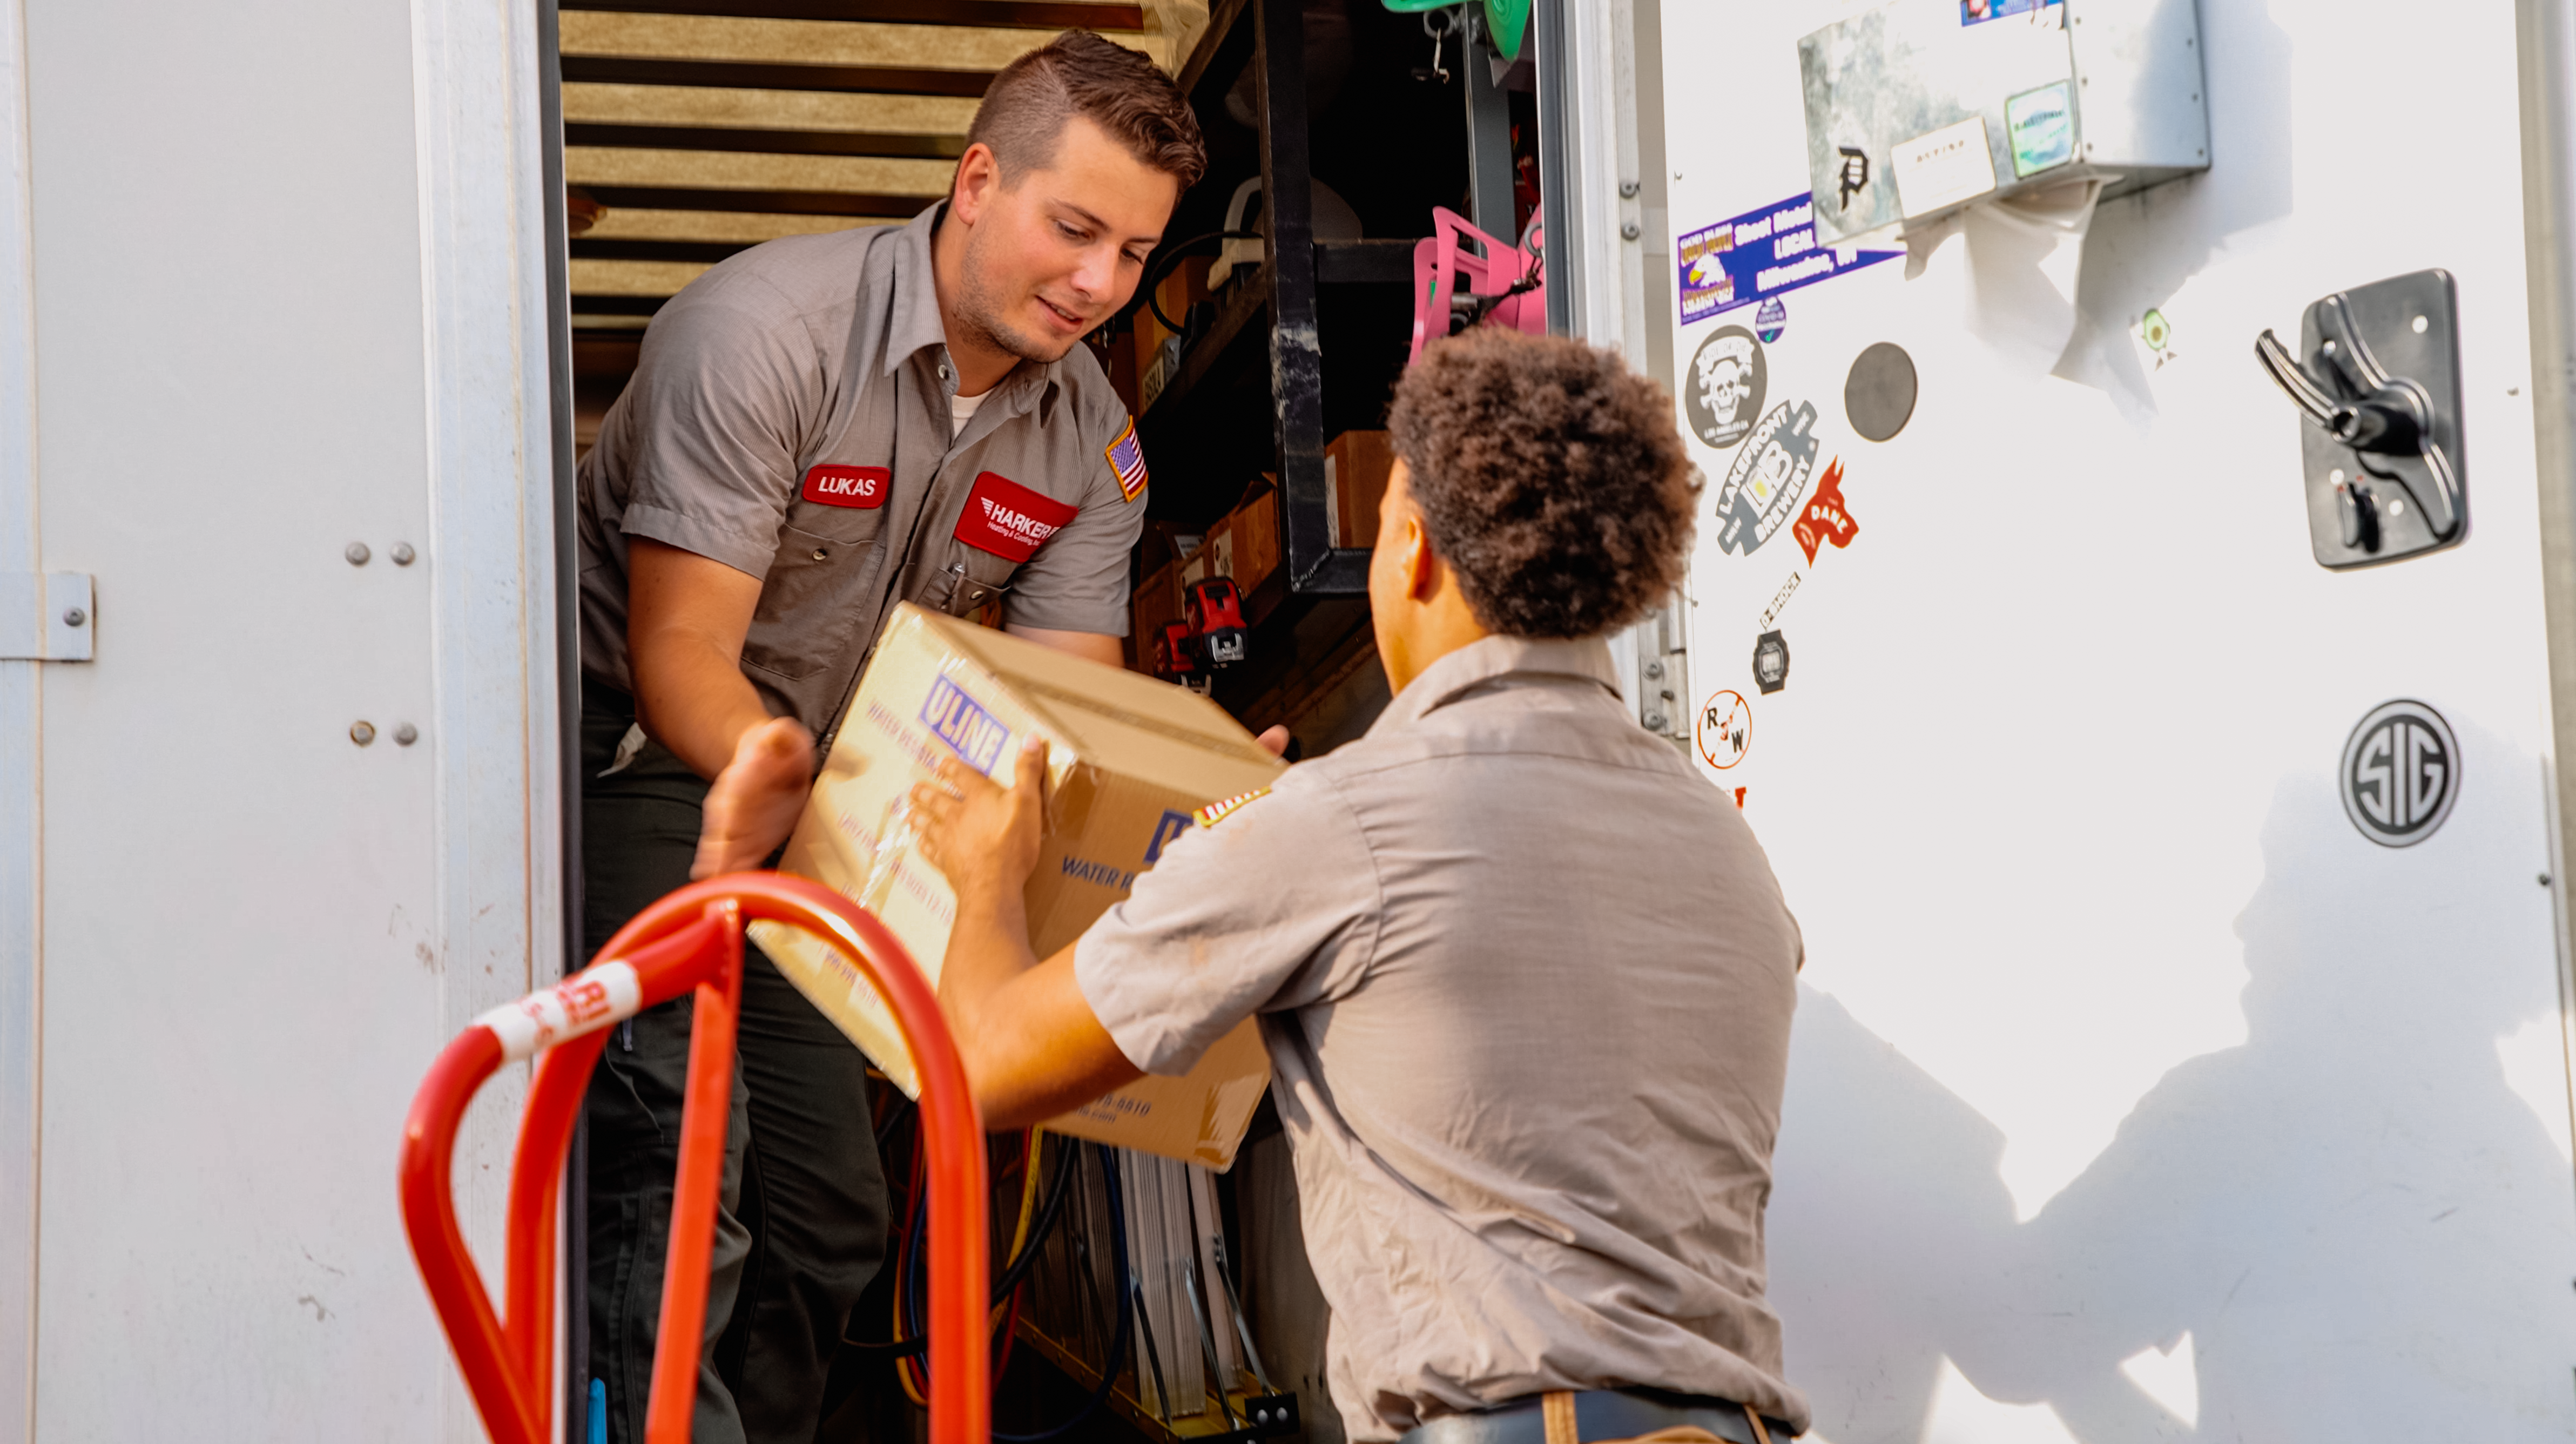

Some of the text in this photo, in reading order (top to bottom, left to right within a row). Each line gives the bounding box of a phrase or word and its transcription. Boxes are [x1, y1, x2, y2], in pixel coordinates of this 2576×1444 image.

[1719, 404, 1788, 515] LAKEFRONT
[819, 476, 876, 496] LUKAS
[1754, 454, 1810, 543] BREWERY
[987, 521, 1009, 537] Heating
[1811, 505, 1849, 535] DANE
[926, 680, 1004, 772] ULINE
[1707, 706, 1718, 730] R
[2356, 722, 2445, 827] SIG
[1061, 854, 1120, 889] WATER
